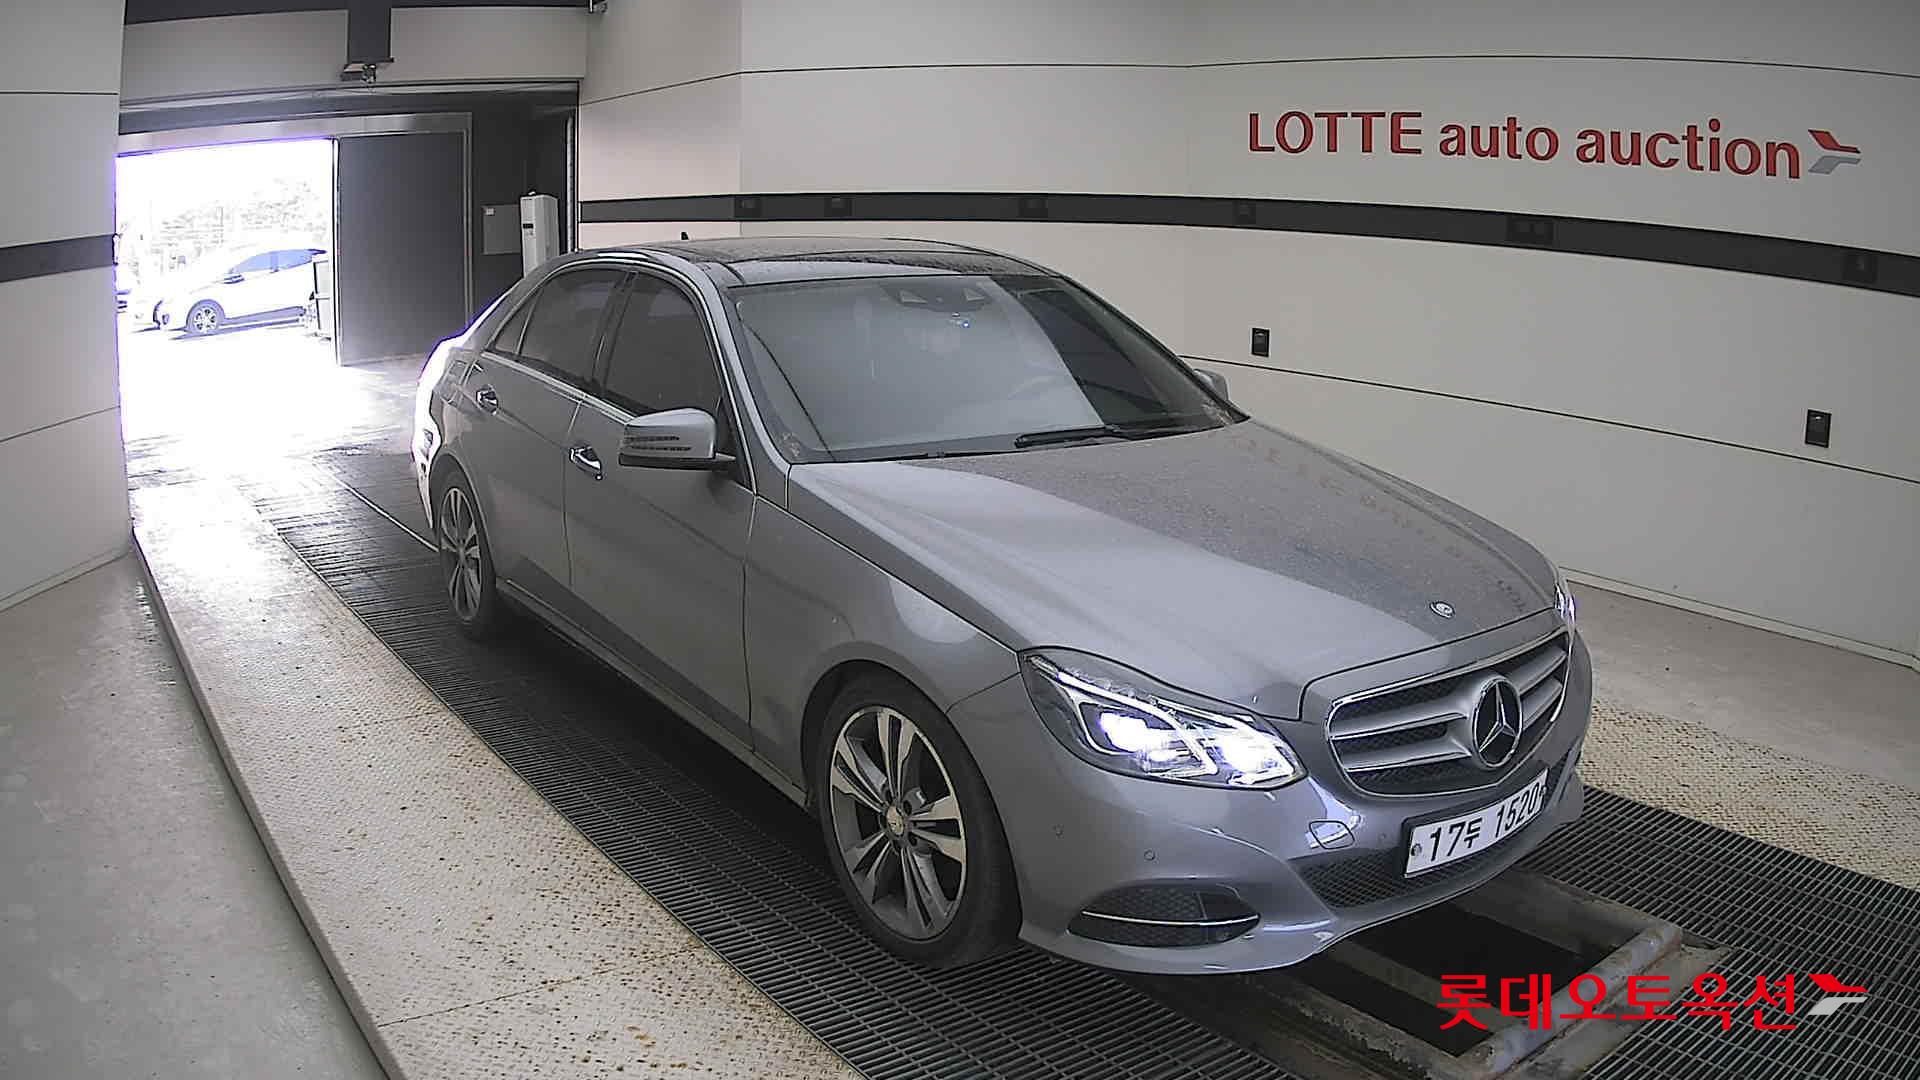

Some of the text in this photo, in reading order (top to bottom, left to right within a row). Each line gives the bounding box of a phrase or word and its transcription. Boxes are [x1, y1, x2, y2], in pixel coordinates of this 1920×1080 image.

[1248, 111, 1802, 179] LOTTE auto auction
[1429, 782, 1541, 862] 17두 1520
